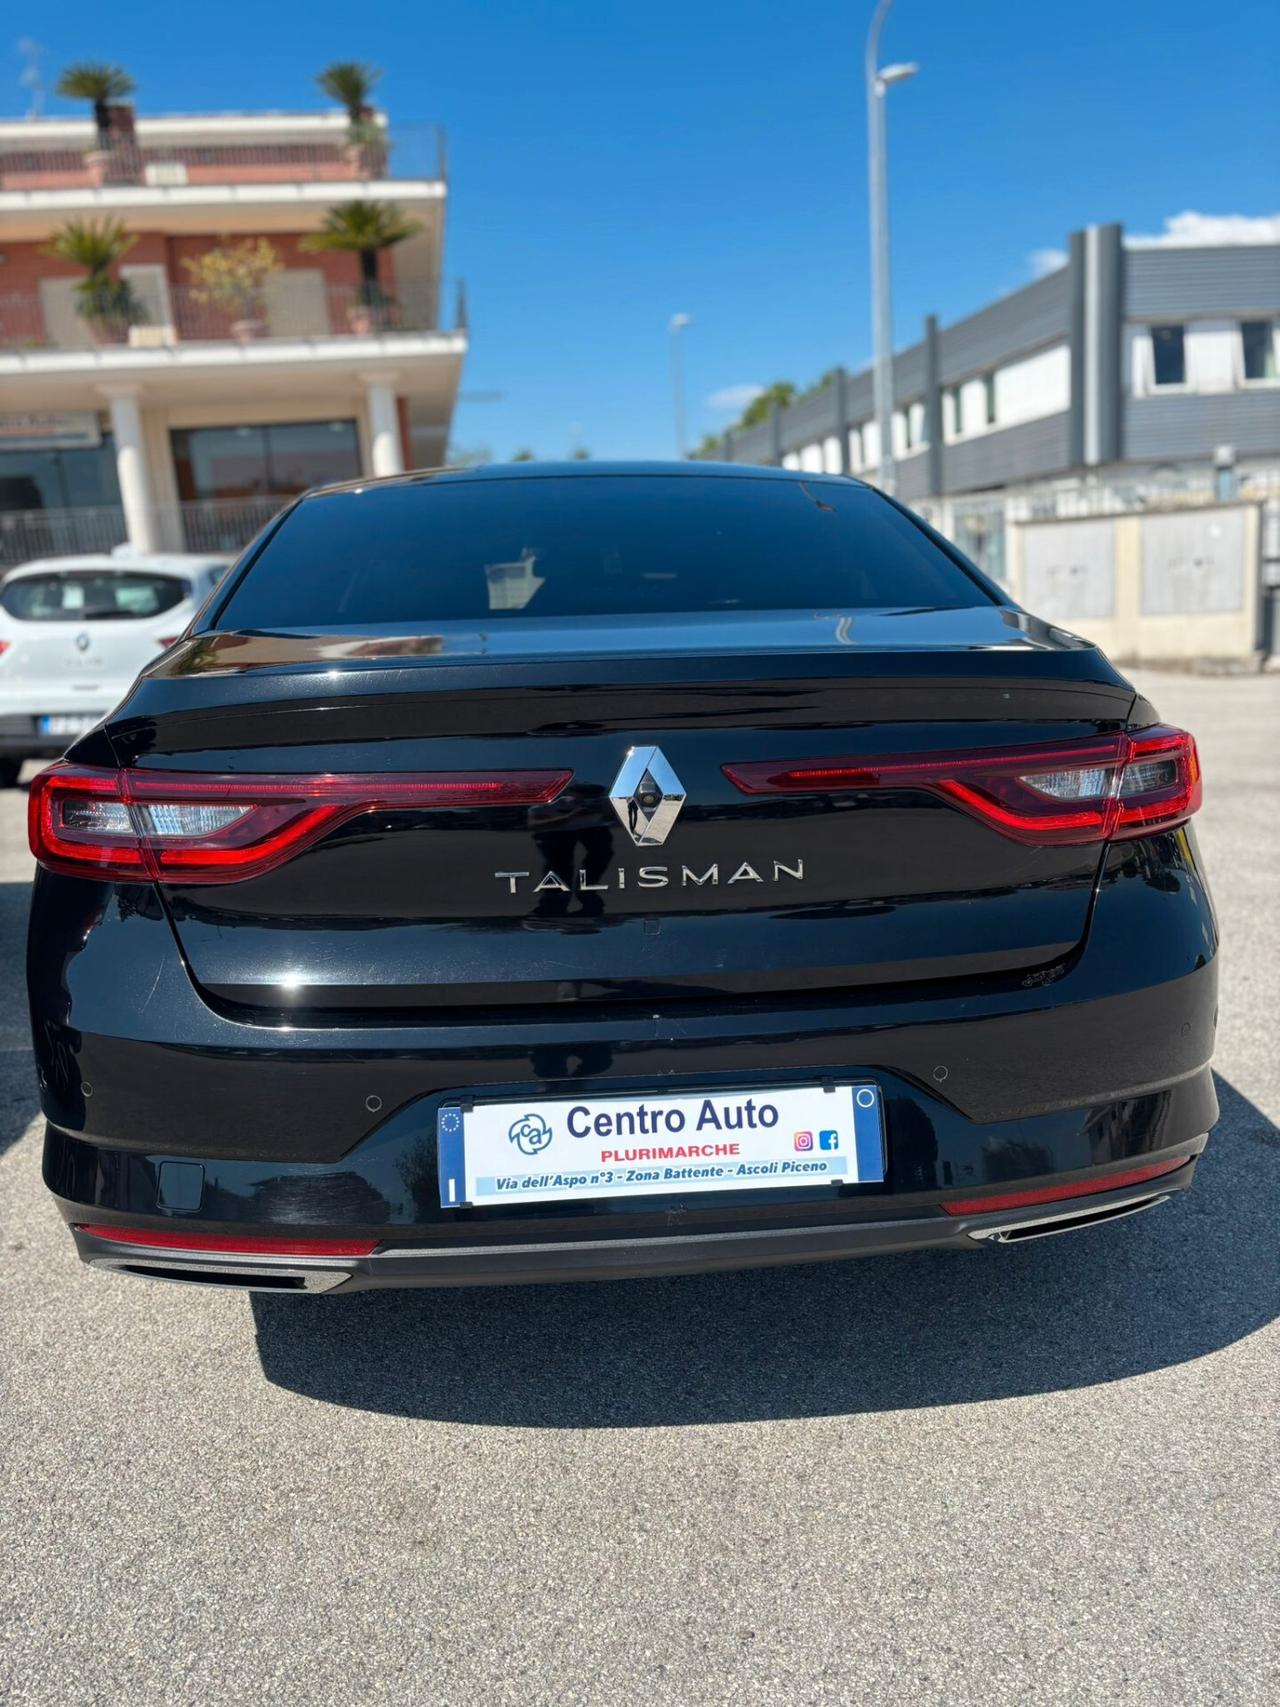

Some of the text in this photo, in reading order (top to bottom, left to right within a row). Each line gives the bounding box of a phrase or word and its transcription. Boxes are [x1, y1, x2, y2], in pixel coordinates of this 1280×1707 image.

[495, 859, 803, 894] TALISMAN
[567, 1098, 779, 1138] Centro Auto
[601, 1143, 741, 1163] PLURIMARCHE
[496, 1178, 518, 1190] Via
[626, 1169, 660, 1182] Zona
[664, 1166, 724, 1180] Battente
[736, 1162, 778, 1176] Ascoli
[781, 1160, 828, 1173] Piceno
